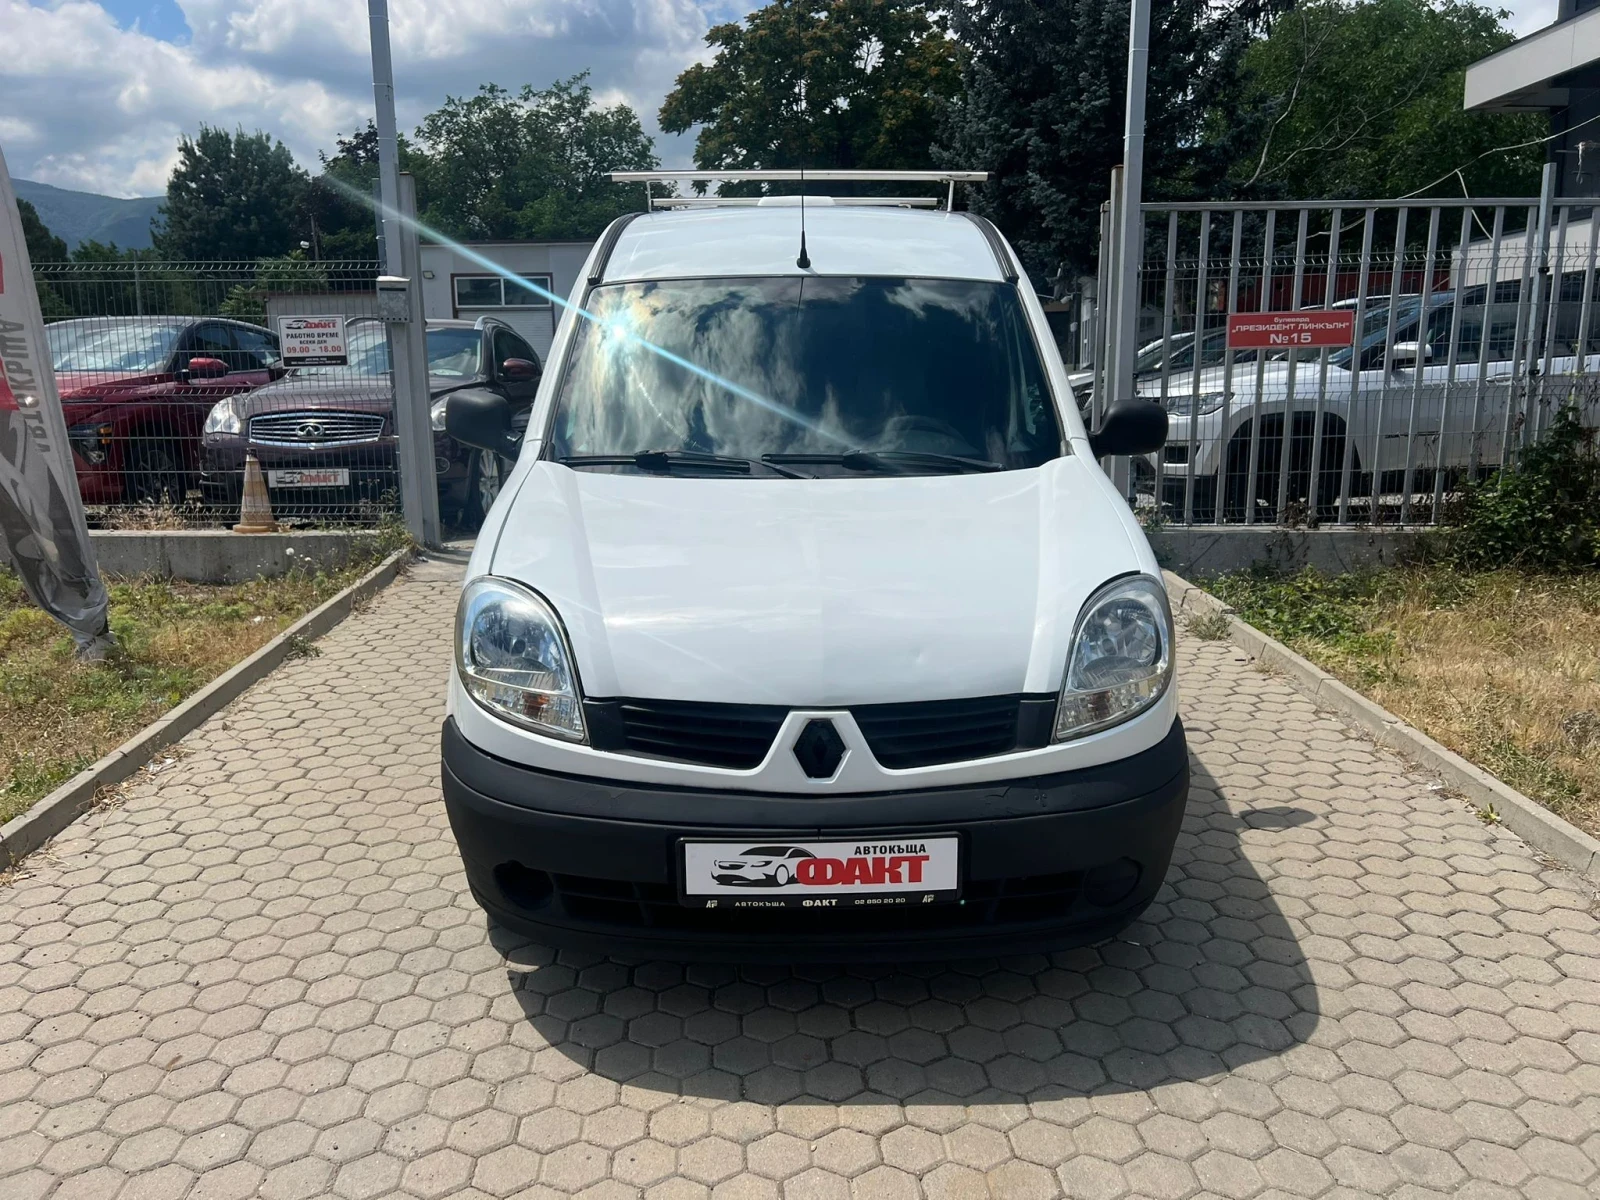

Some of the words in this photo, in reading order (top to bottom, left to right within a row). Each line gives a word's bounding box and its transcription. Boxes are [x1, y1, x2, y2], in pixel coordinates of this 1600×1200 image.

[319, 345, 342, 353] 18.00
[854, 844, 927, 855] АВТОКЪЩА
[796, 855, 930, 886] ФАКТ
[802, 899, 838, 907] ФАКТ
